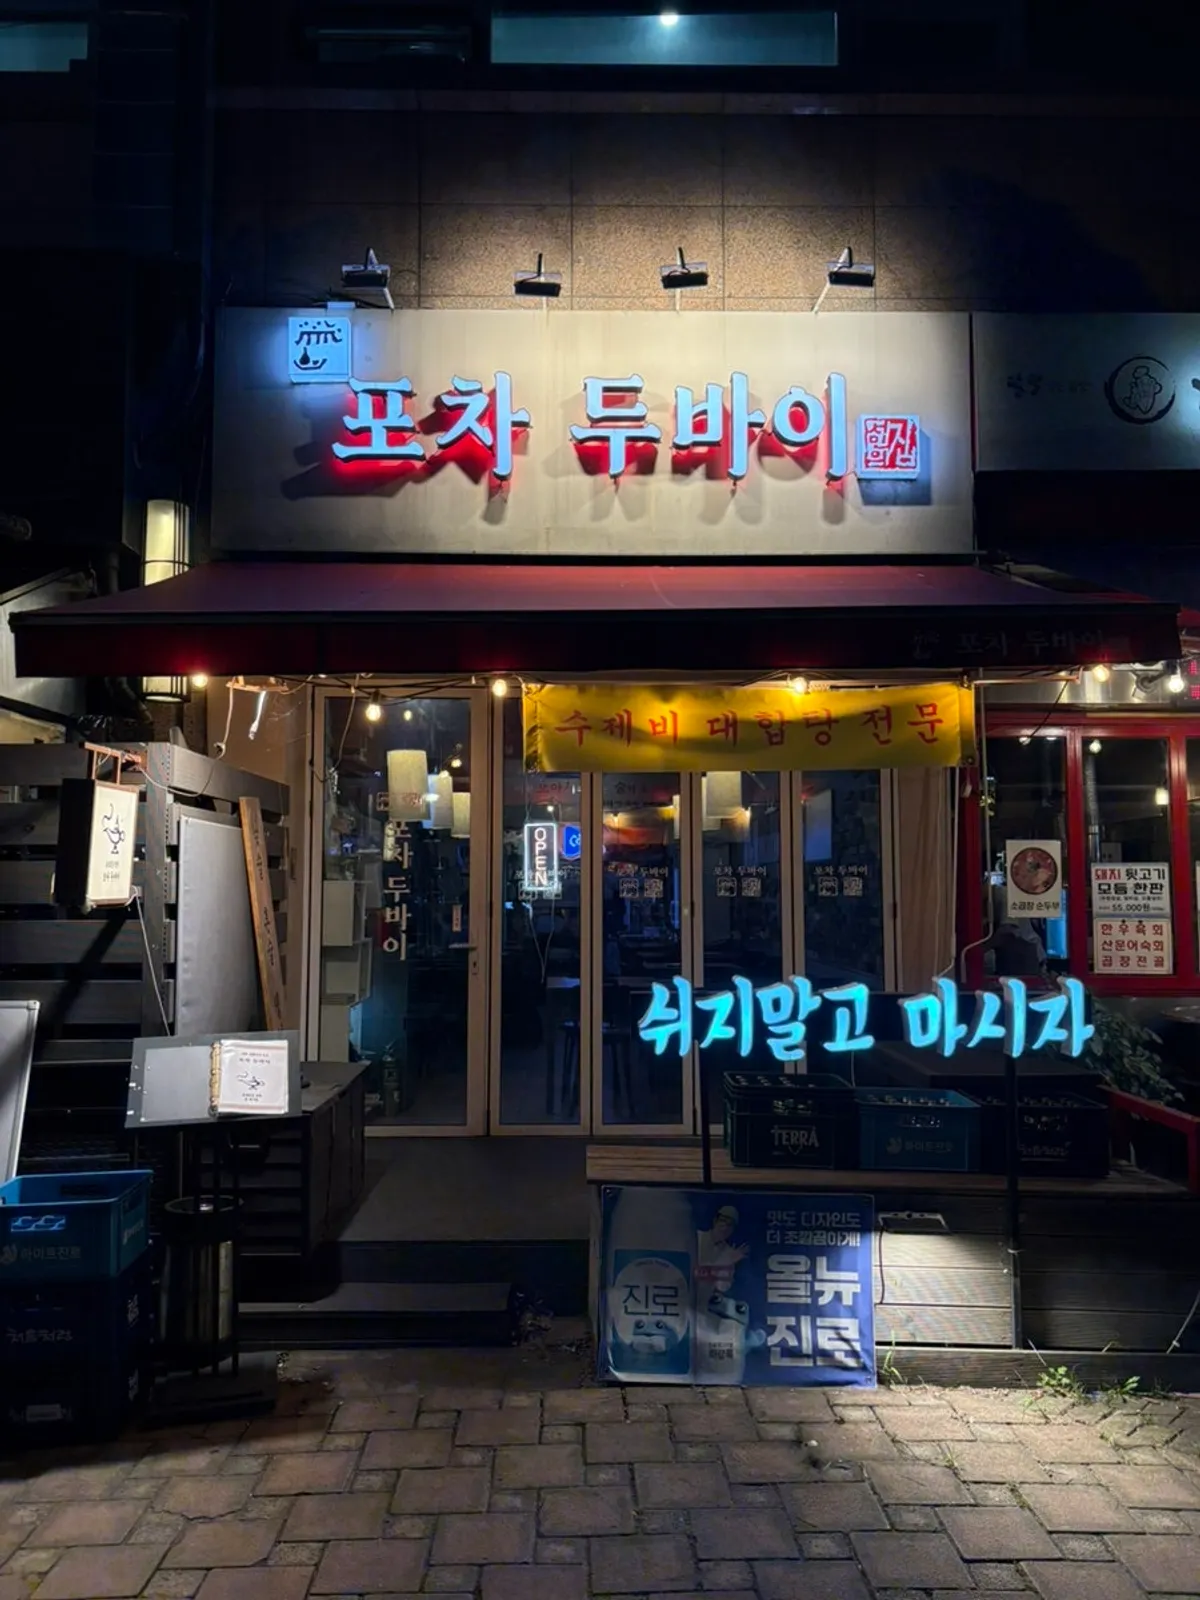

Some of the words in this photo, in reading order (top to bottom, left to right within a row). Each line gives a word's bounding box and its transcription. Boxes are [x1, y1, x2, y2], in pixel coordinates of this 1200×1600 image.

[332, 371, 531, 481] 포차
[569, 371, 848, 481] 두바이
[954, 632, 1008, 658] 포차
[1022, 629, 1104, 658] 두바이
[555, 709, 679, 748] 수제비
[707, 707, 839, 747] 대합탕
[864, 702, 945, 745] 전문
[534, 827, 548, 885] OPEN
[837, 864, 868, 877] 두바이
[737, 865, 767, 878] 두바이
[1095, 868, 1122, 881] 돼지
[1125, 867, 1166, 881] 뒷고기
[1097, 882, 1128, 895] 모듬
[1133, 882, 1164, 895] 한판
[382, 876, 413, 961] 두바이
[638, 974, 876, 1062] 쉬지말고
[901, 974, 1095, 1058] 마시자
[771, 1125, 820, 1149] TERRA
[800, 1211, 862, 1228] 디자인도
[766, 1229, 781, 1245] 더
[622, 1284, 680, 1317] 진로
[766, 1314, 865, 1370] 진로
